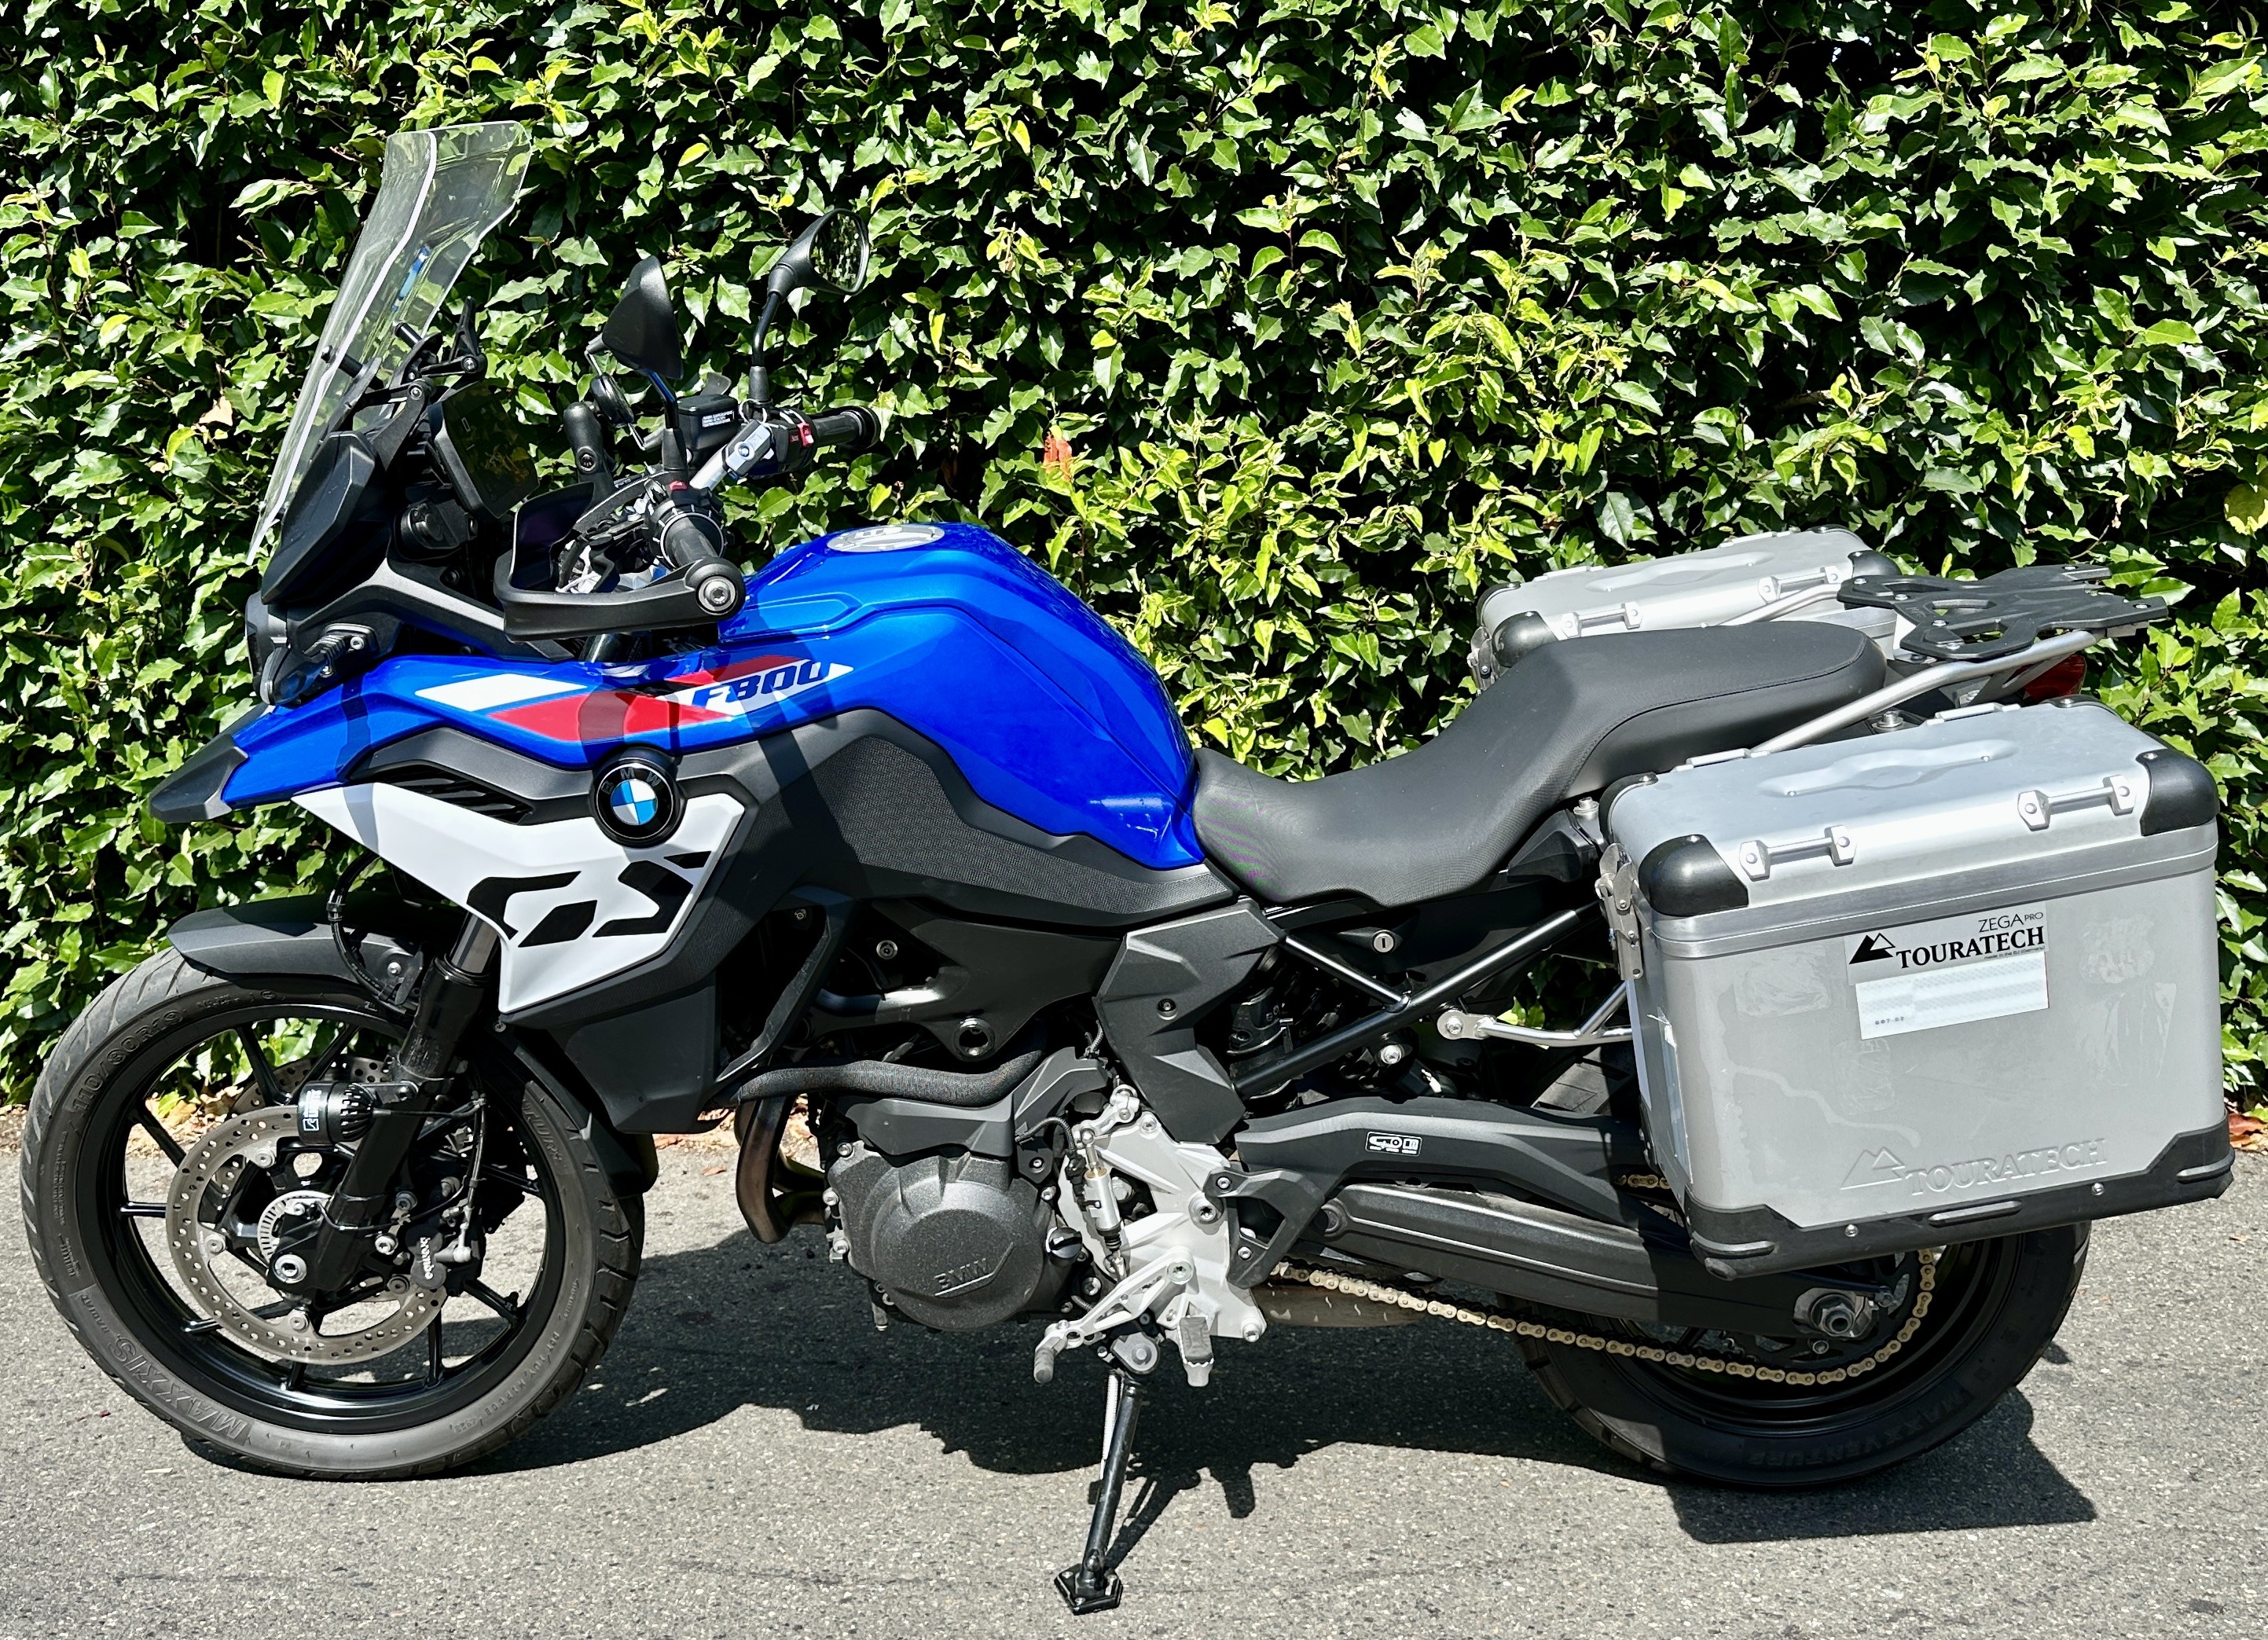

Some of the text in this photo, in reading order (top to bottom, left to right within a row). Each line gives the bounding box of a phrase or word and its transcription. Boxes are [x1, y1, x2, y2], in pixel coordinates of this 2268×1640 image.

[692, 660, 829, 709] F800
[601, 767, 661, 794] BMW
[1978, 912, 2043, 933] ZEGA PRO
[1896, 926, 2044, 969] TOURATECH
[1905, 1139, 2107, 1195] TOURATECH
[420, 1237, 435, 1279] brembo
[107, 1335, 248, 1440] MAXXIS
